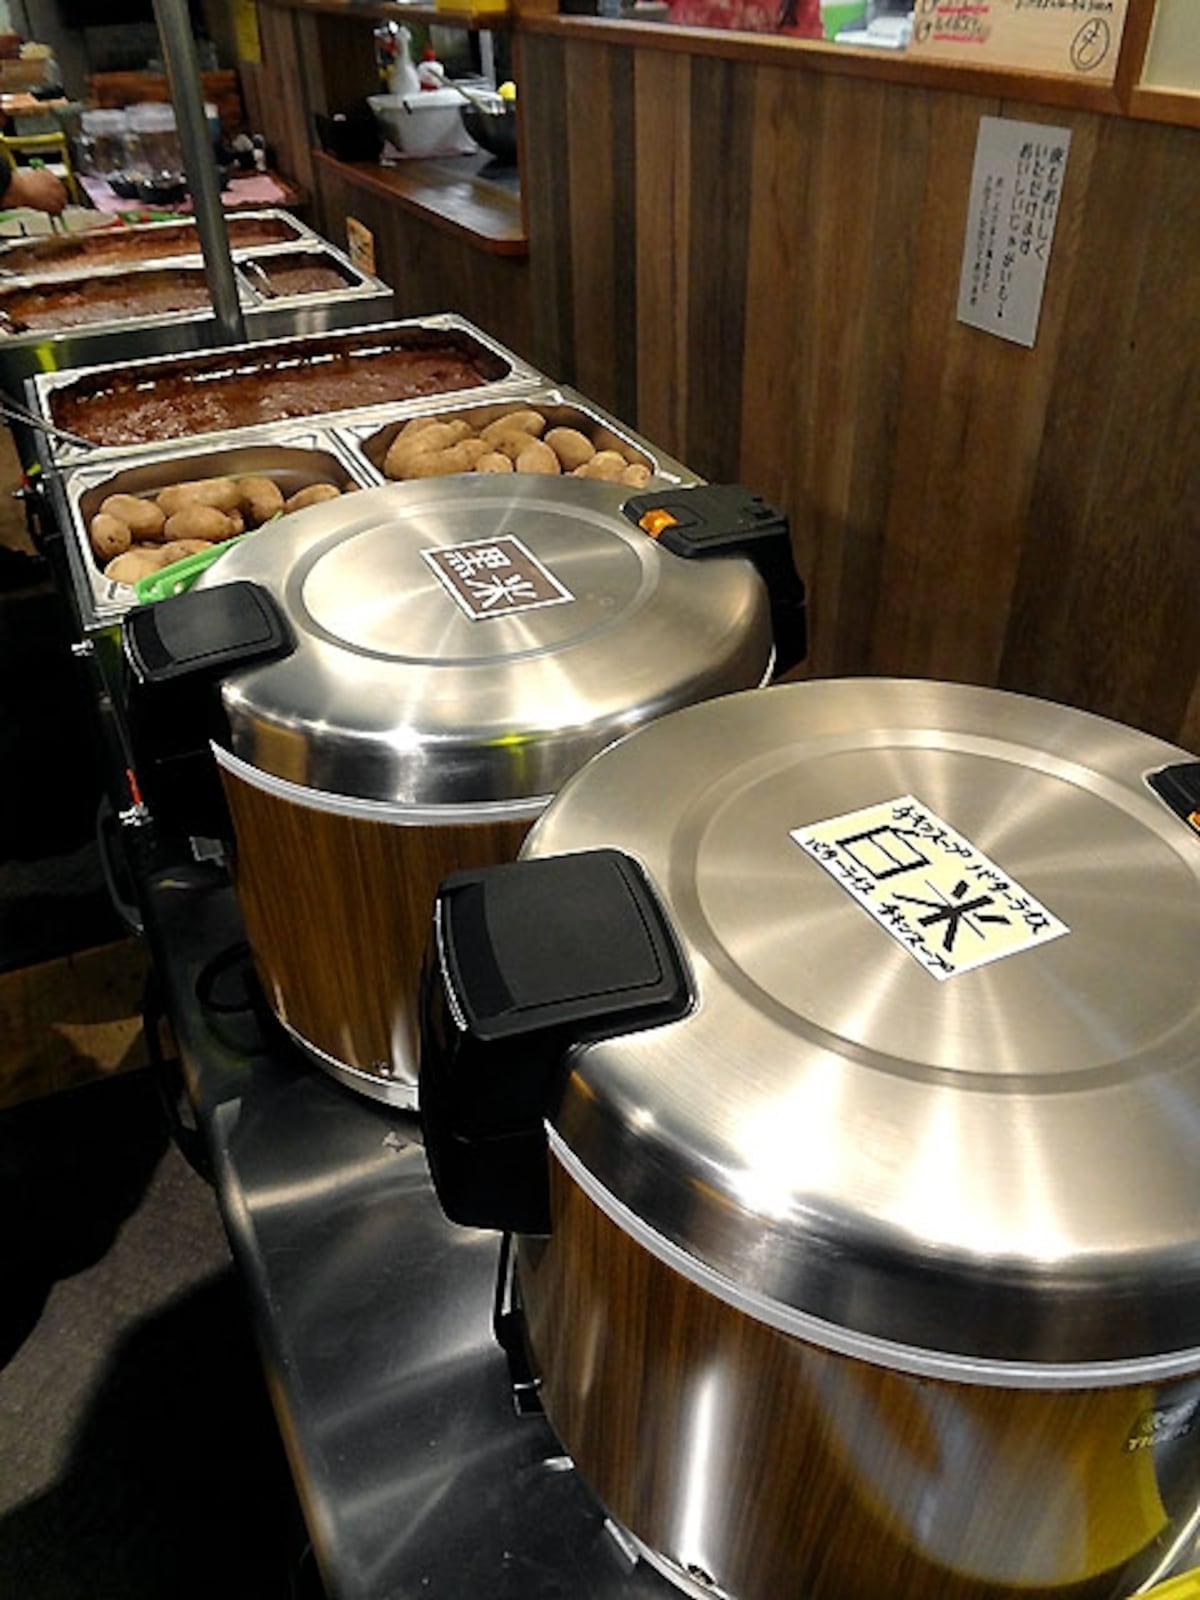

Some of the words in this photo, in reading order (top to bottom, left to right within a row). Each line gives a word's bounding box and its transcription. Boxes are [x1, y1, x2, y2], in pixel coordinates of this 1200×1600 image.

[443, 546, 538, 609] 黒米
[804, 837, 877, 896] バターライス
[878, 902, 956, 974] チキンスープ
[835, 825, 1013, 953] 白米
[965, 861, 1052, 936] バターライス
